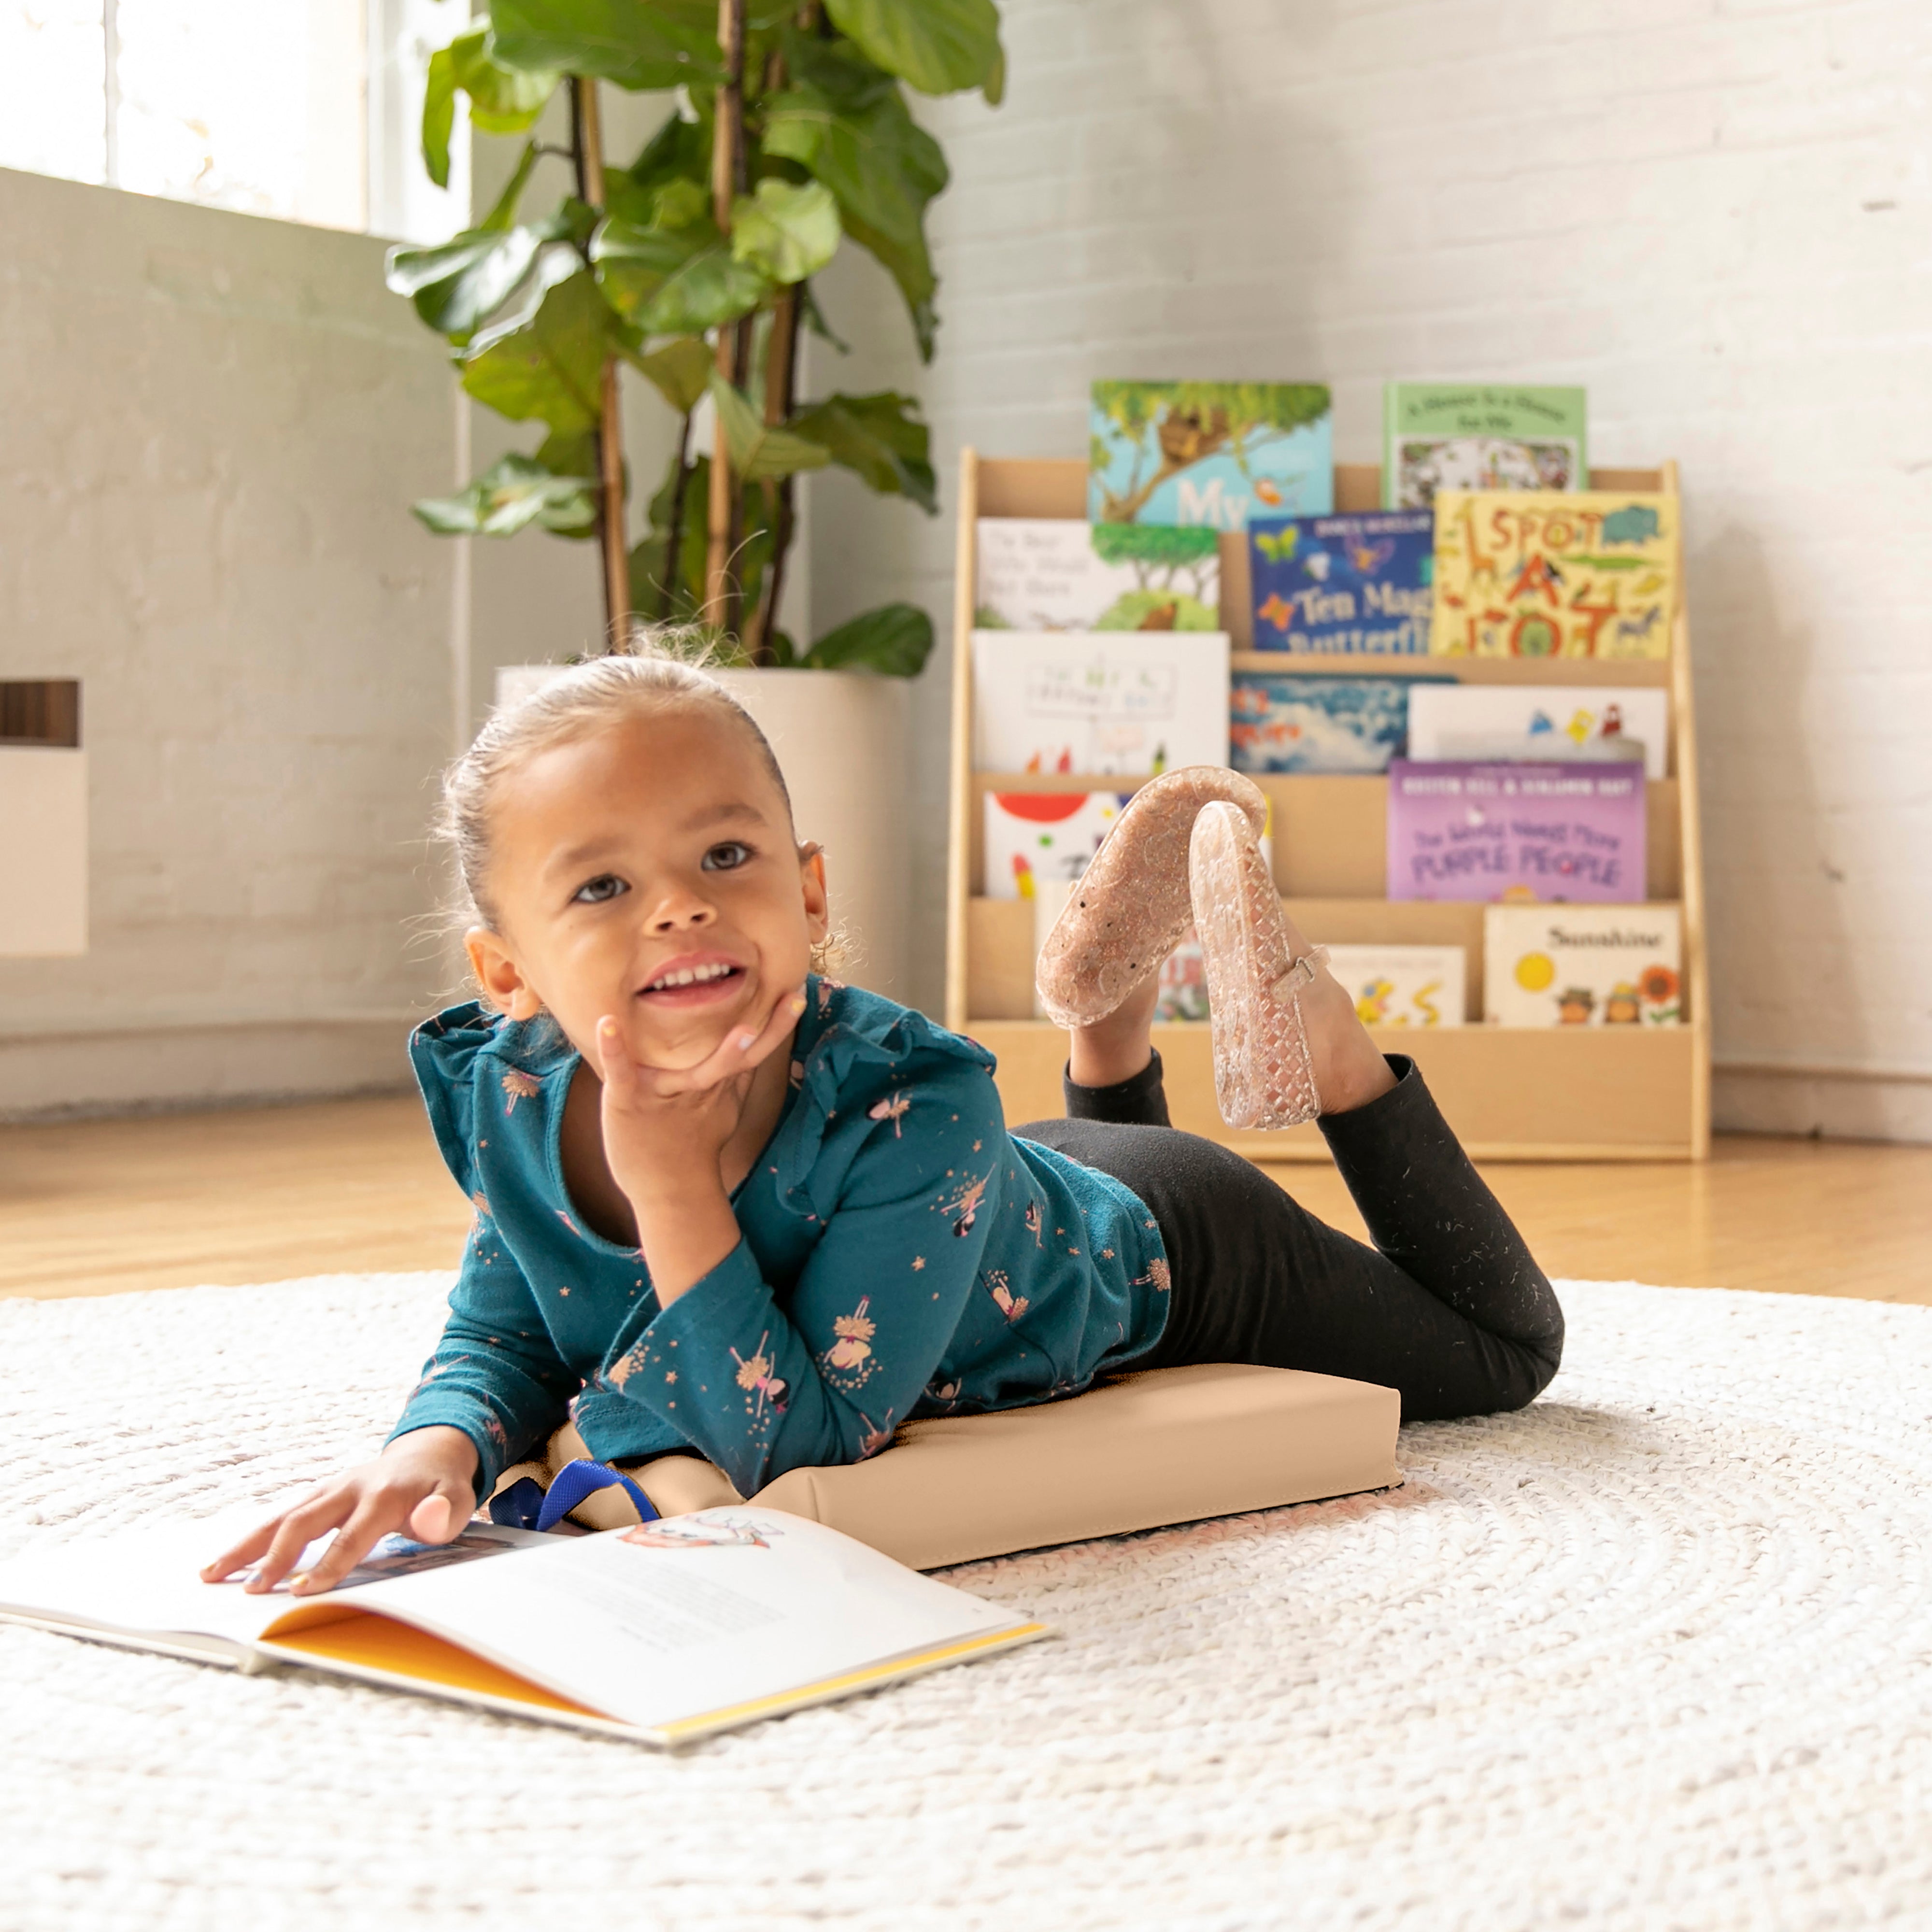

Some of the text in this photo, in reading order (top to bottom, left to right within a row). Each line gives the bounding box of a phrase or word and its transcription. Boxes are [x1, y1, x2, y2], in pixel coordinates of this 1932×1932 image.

[1178, 478, 1248, 531] My
[1490, 509, 1603, 554] SPOT
[1506, 553, 1559, 608] A
[1293, 586, 1355, 626] Ten
[1411, 844, 1622, 888] PURPLE PEOPLE
[1547, 924, 1664, 950] Sunshine
